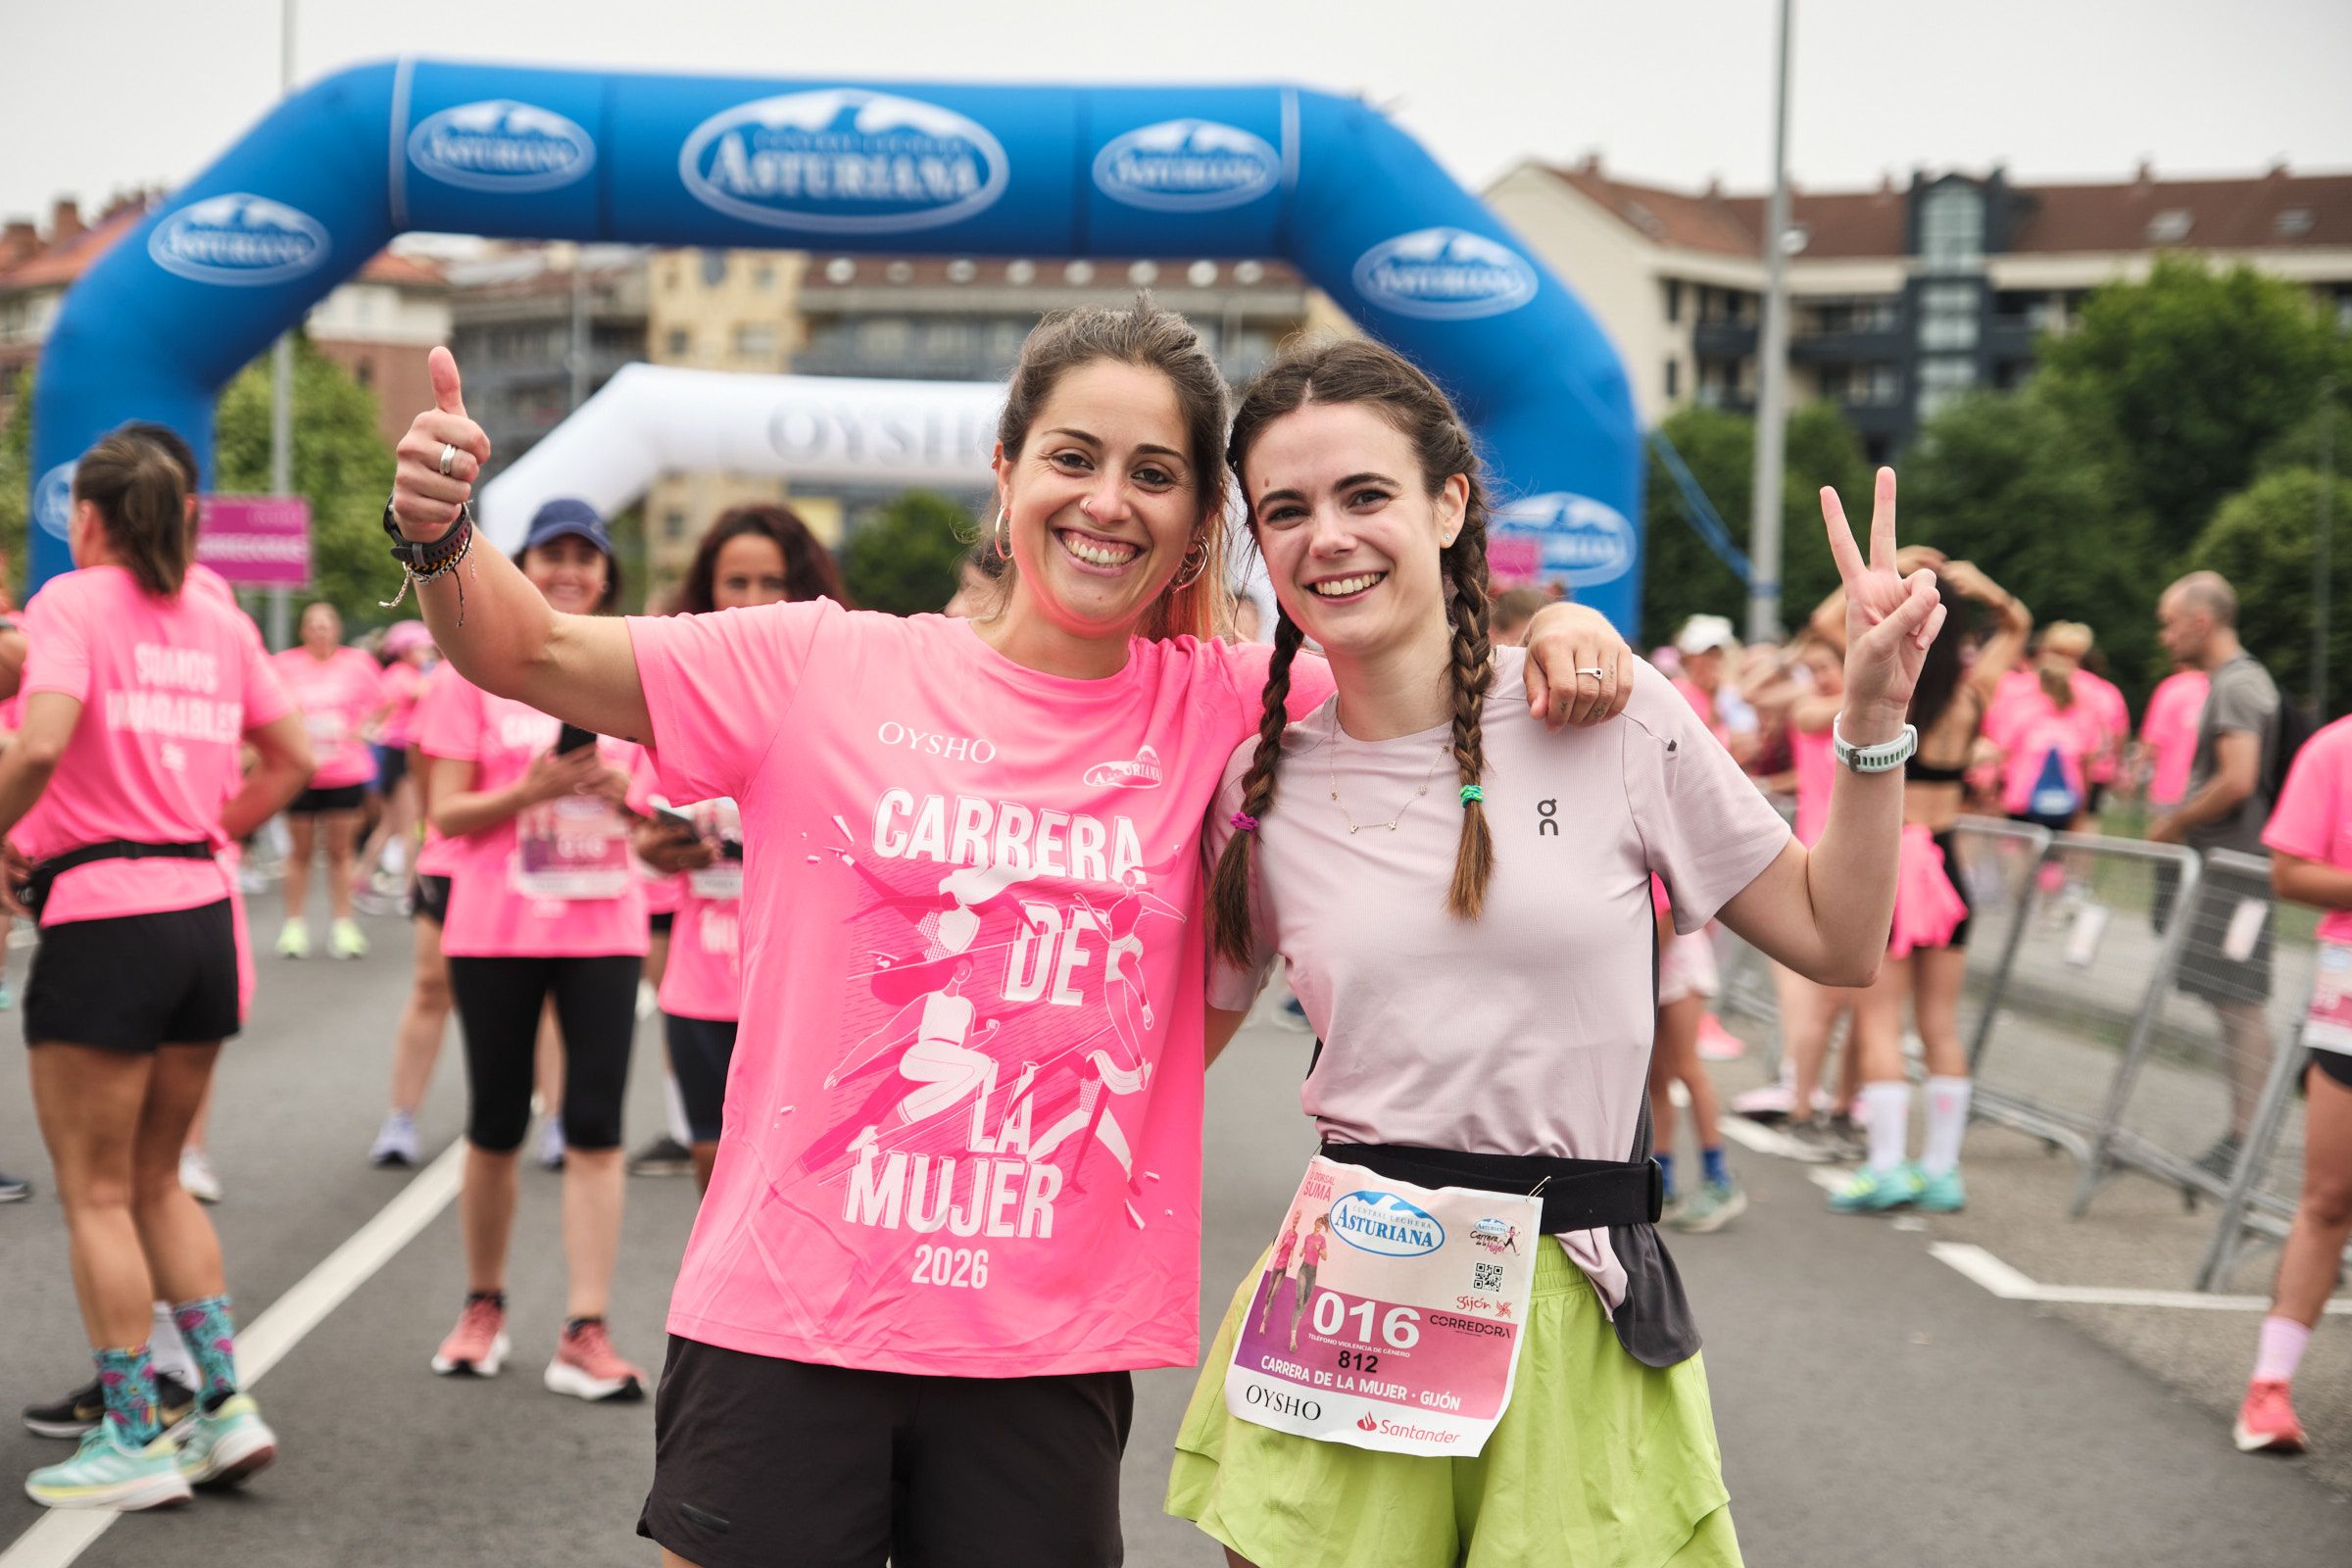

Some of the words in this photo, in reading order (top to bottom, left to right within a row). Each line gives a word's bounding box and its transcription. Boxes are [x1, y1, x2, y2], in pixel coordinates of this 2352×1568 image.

[708, 130, 981, 200] ASTURIANA
[878, 721, 996, 763] OYSHO
[871, 787, 1147, 884] CARRERA
[1000, 900, 1110, 1005] DE
[967, 1058, 1039, 1154] LA
[842, 1142, 1063, 1239] MUJER
[1303, 1181, 1332, 1201] SUMA
[1335, 1204, 1434, 1248] ASTURIANA
[1352, 1204, 1387, 1220] CENTRAL
[1390, 1215, 1432, 1229] LECHERA
[1470, 1230, 1498, 1242] Carrera
[911, 1244, 989, 1289] 2026
[1313, 1292, 1421, 1349] 016
[1456, 1296, 1492, 1311] gijón
[1338, 1341, 1372, 1352] VIOLENCIA
[1430, 1314, 1511, 1339] CORREDORA
[1260, 1354, 1309, 1383] CARRERA
[1313, 1370, 1333, 1387] DE
[1336, 1374, 1354, 1391] LA
[1359, 1378, 1407, 1401] MUJER
[1420, 1389, 1462, 1411] GIJÓN
[1338, 1349, 1379, 1374] 812
[1246, 1384, 1322, 1421] OYSHO
[1379, 1419, 1461, 1444] Santander
